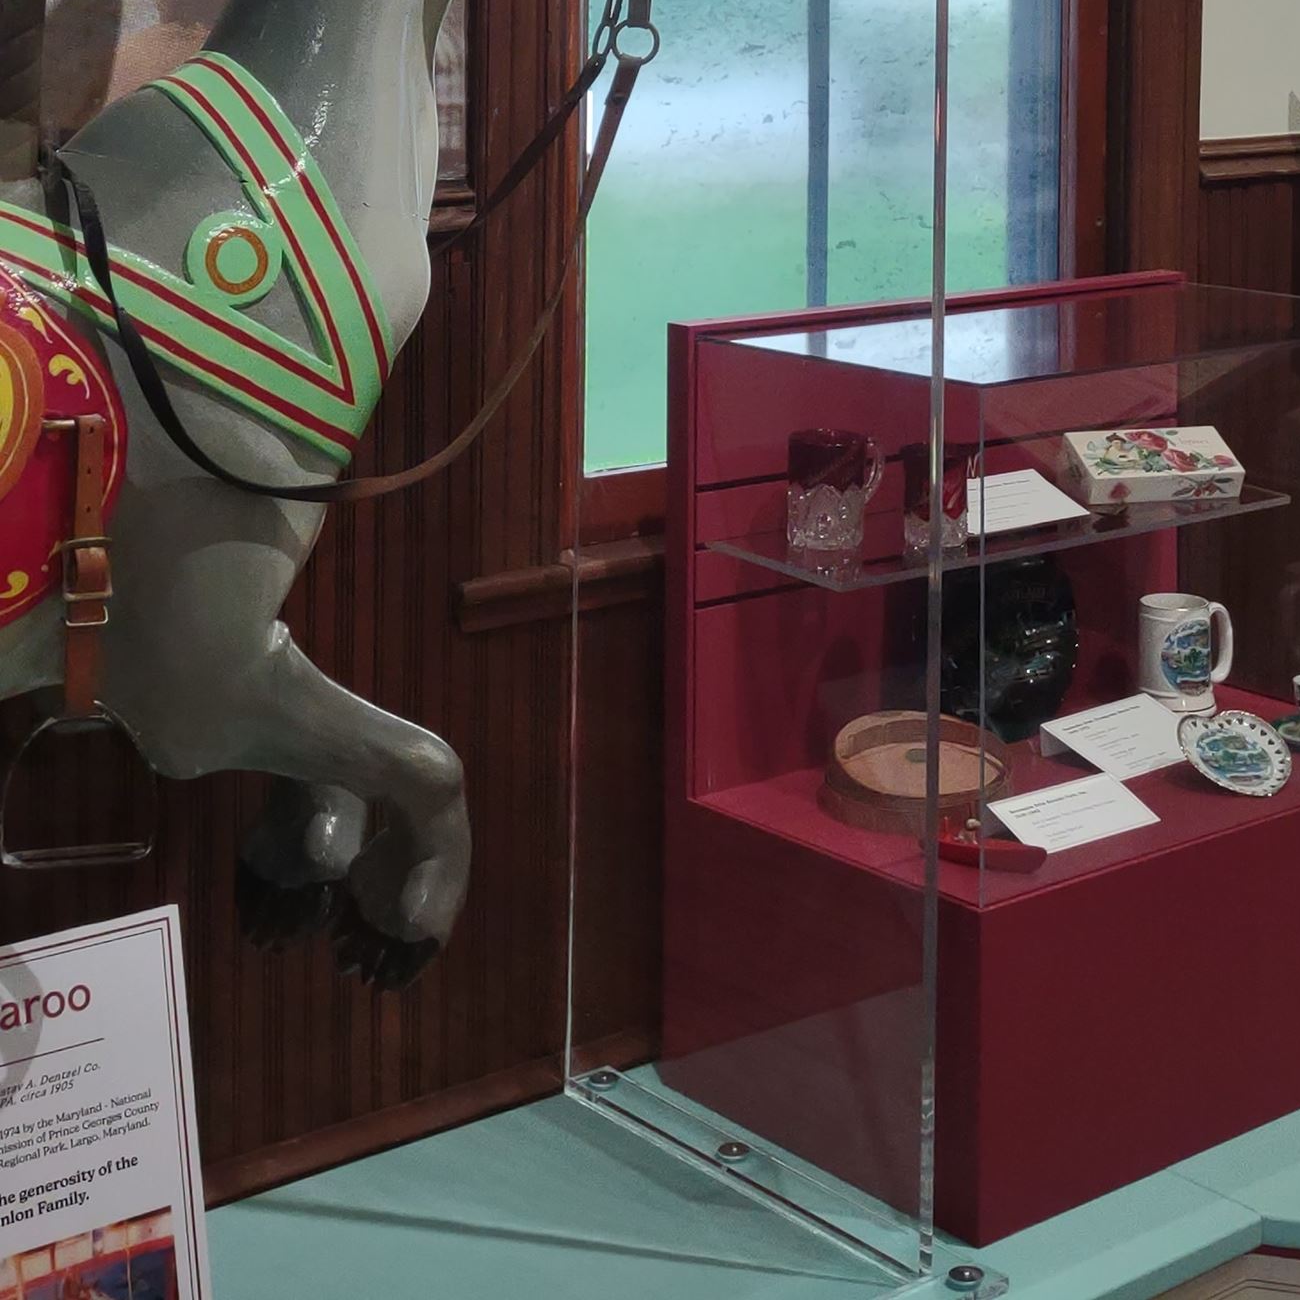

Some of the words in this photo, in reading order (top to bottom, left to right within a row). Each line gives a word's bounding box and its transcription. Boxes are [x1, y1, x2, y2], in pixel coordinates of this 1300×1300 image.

[20, 1088, 47, 1103] circa
[50, 1080, 74, 1095] 1905
[25, 1079, 37, 1090] A.
[40, 1065, 82, 1086] Dentzel
[84, 1062, 101, 1073] Co.
[0, 1125, 20, 1140] 1974
[22, 1122, 35, 1134] by
[37, 1116, 54, 1129] the
[55, 1102, 103, 1124] Maryland
[110, 1088, 152, 1109] National
[36, 1131, 46, 1143] of
[48, 1126, 80, 1141] Prince
[82, 1113, 122, 1131] Georges
[124, 1100, 160, 1118] County
[43, 1142, 69, 1157] Park,
[70, 1134, 100, 1149] Largo,
[102, 1116, 151, 1139] Maryland.
[19, 1169, 95, 1204] generosity
[98, 1160, 112, 1176] of
[115, 1156, 138, 1171] the
[37, 1191, 90, 1216] Family.
